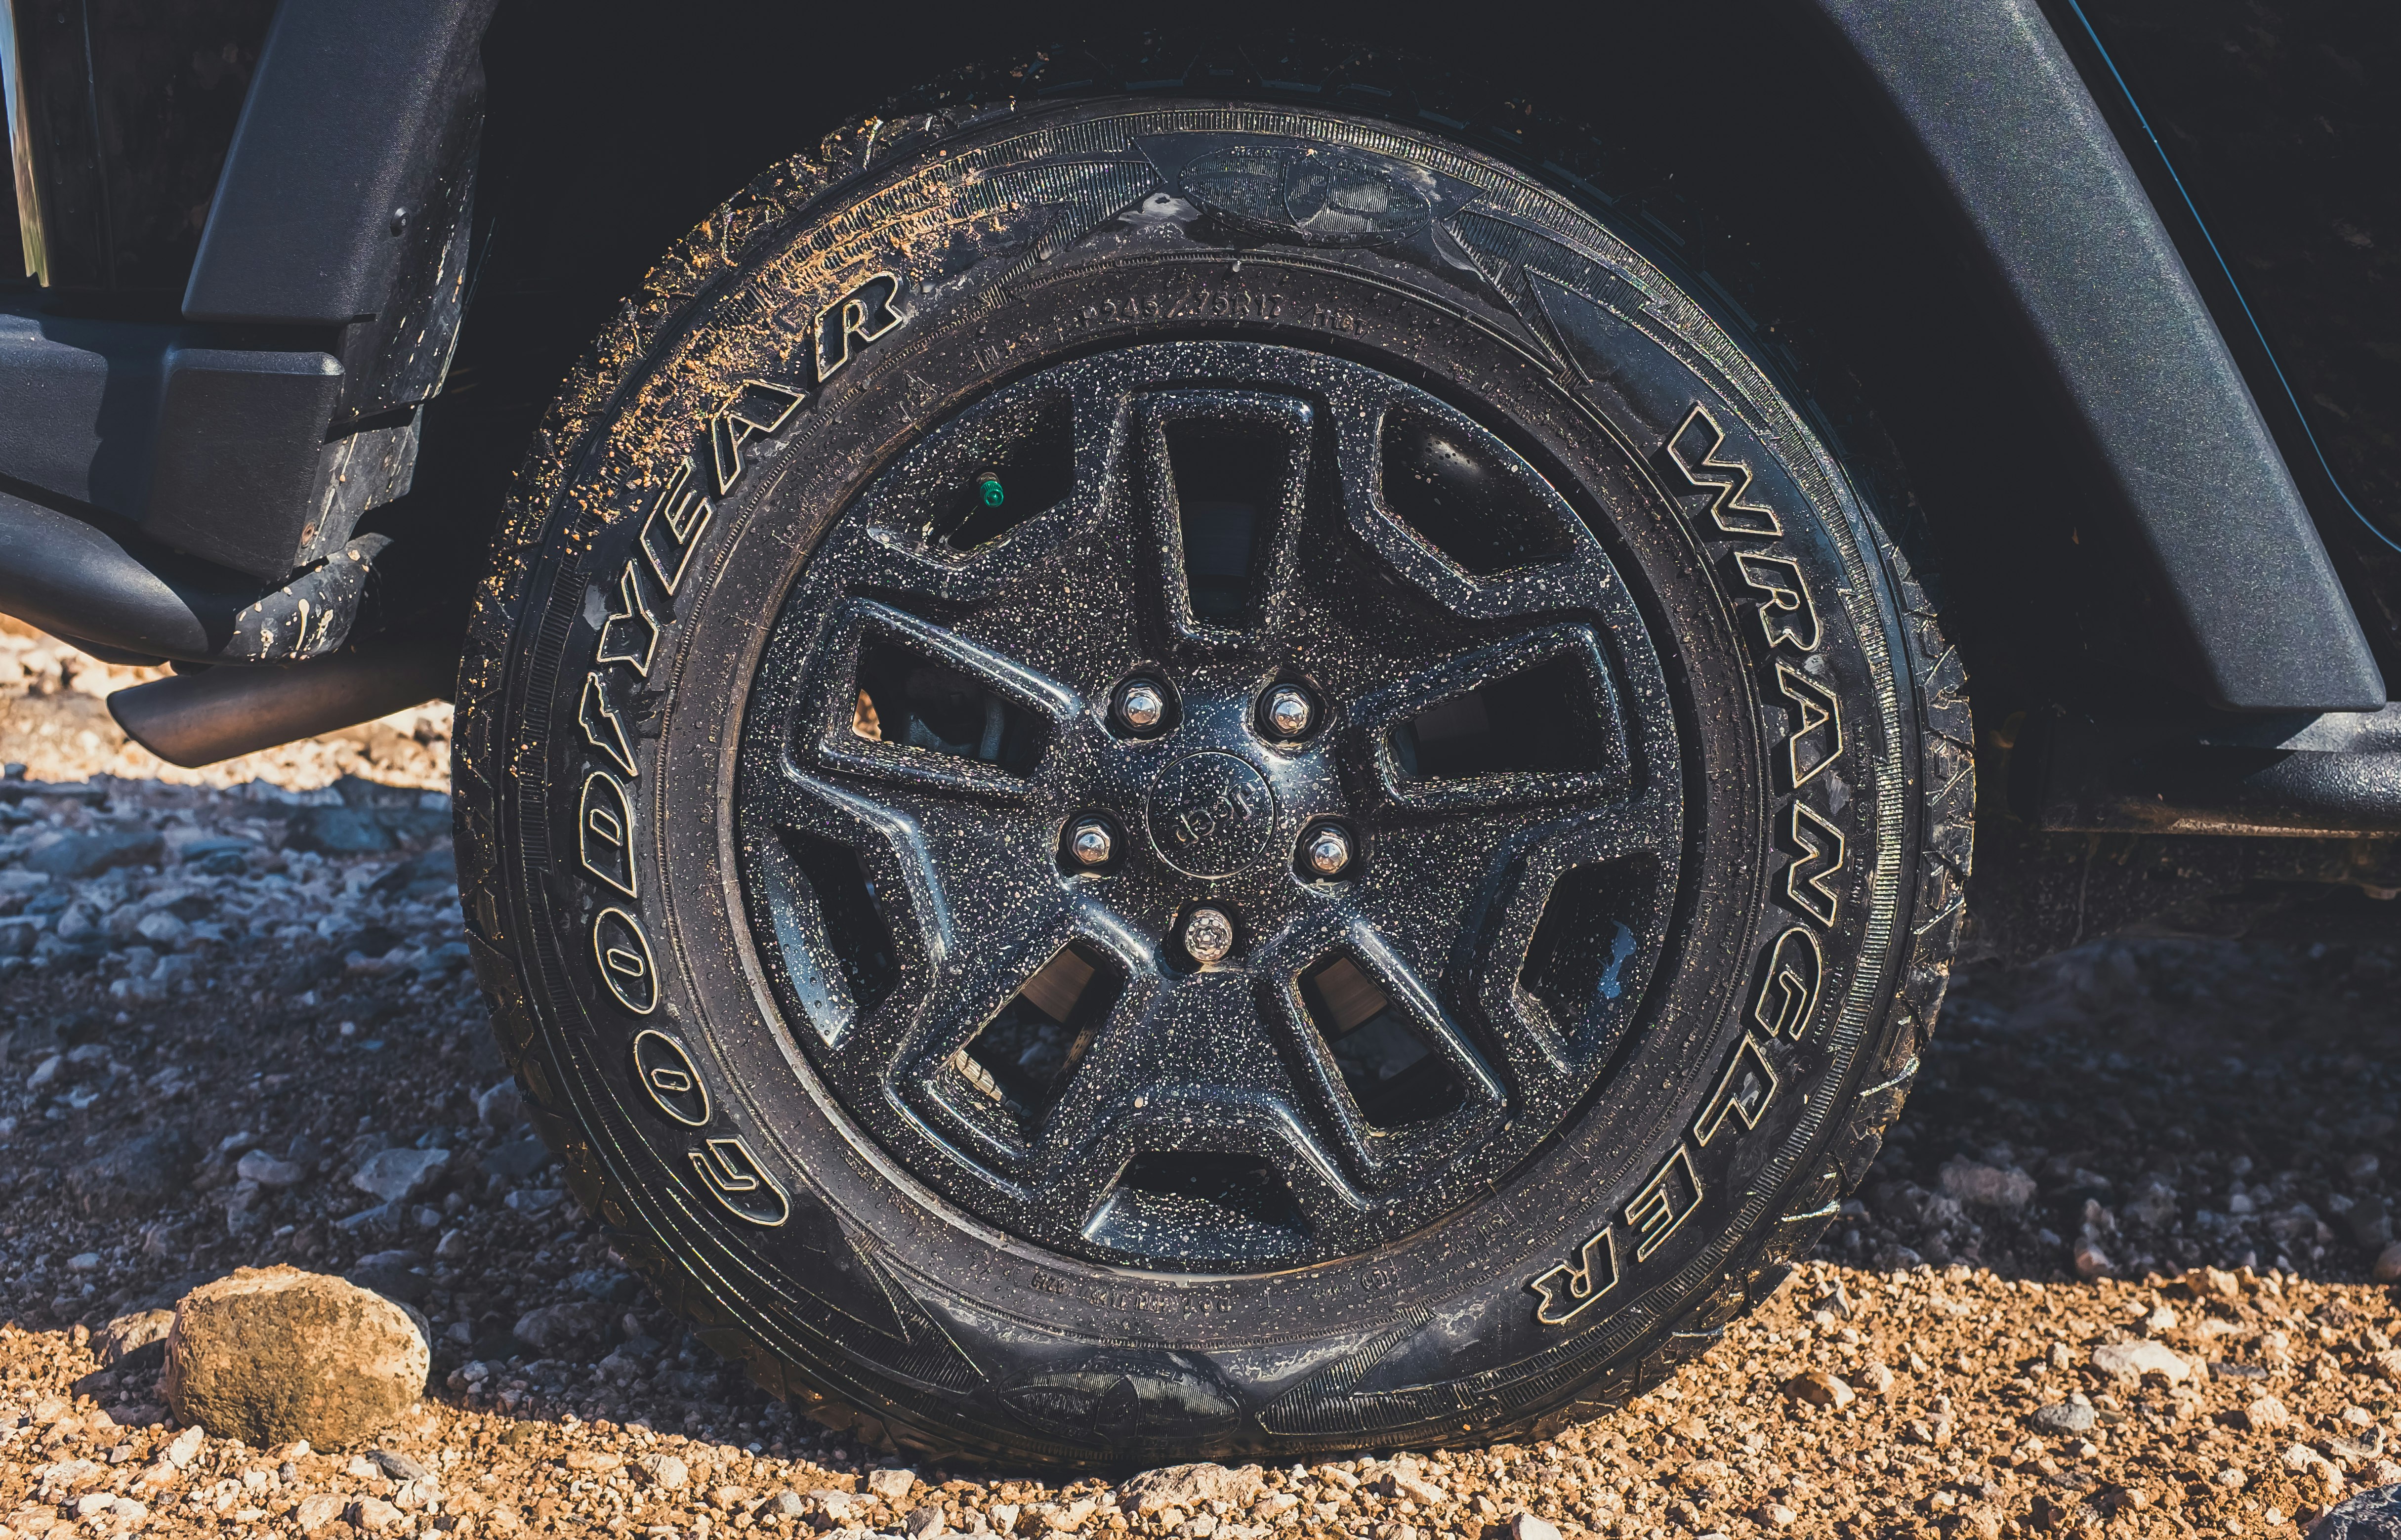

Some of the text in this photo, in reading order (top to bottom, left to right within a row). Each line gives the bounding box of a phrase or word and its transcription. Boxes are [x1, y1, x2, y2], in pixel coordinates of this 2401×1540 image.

[579, 271, 904, 1226] GOODYEAR
[1168, 781, 1257, 851] Jeep
[1532, 406, 1843, 1323] WRANGLER
